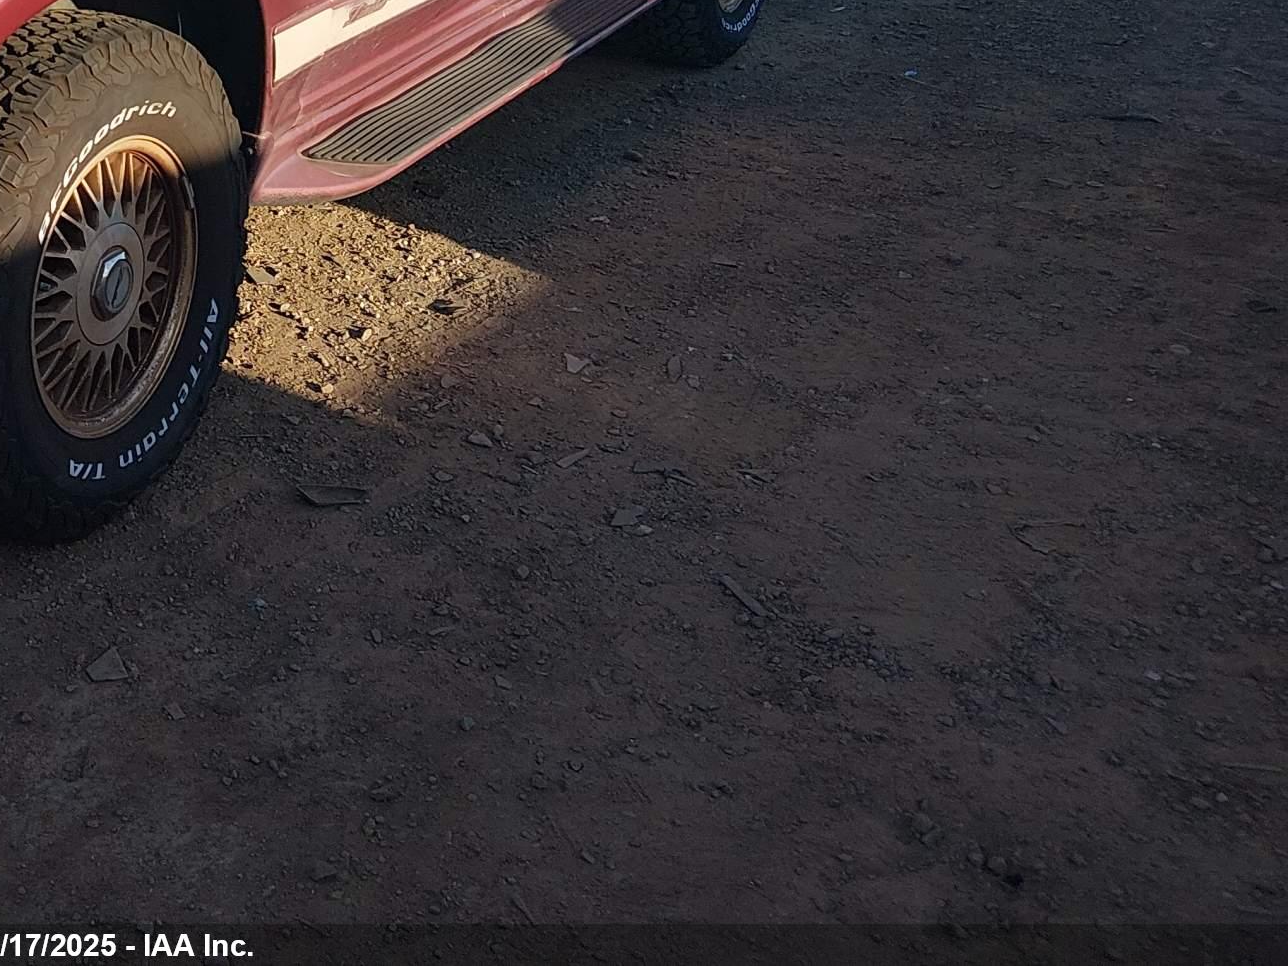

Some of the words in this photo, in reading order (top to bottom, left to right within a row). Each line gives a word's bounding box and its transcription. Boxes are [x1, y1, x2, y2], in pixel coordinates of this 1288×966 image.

[38, 99, 179, 243] BFGoodrich
[118, 297, 221, 470] All-Terrain
[67, 458, 107, 481] T/A
